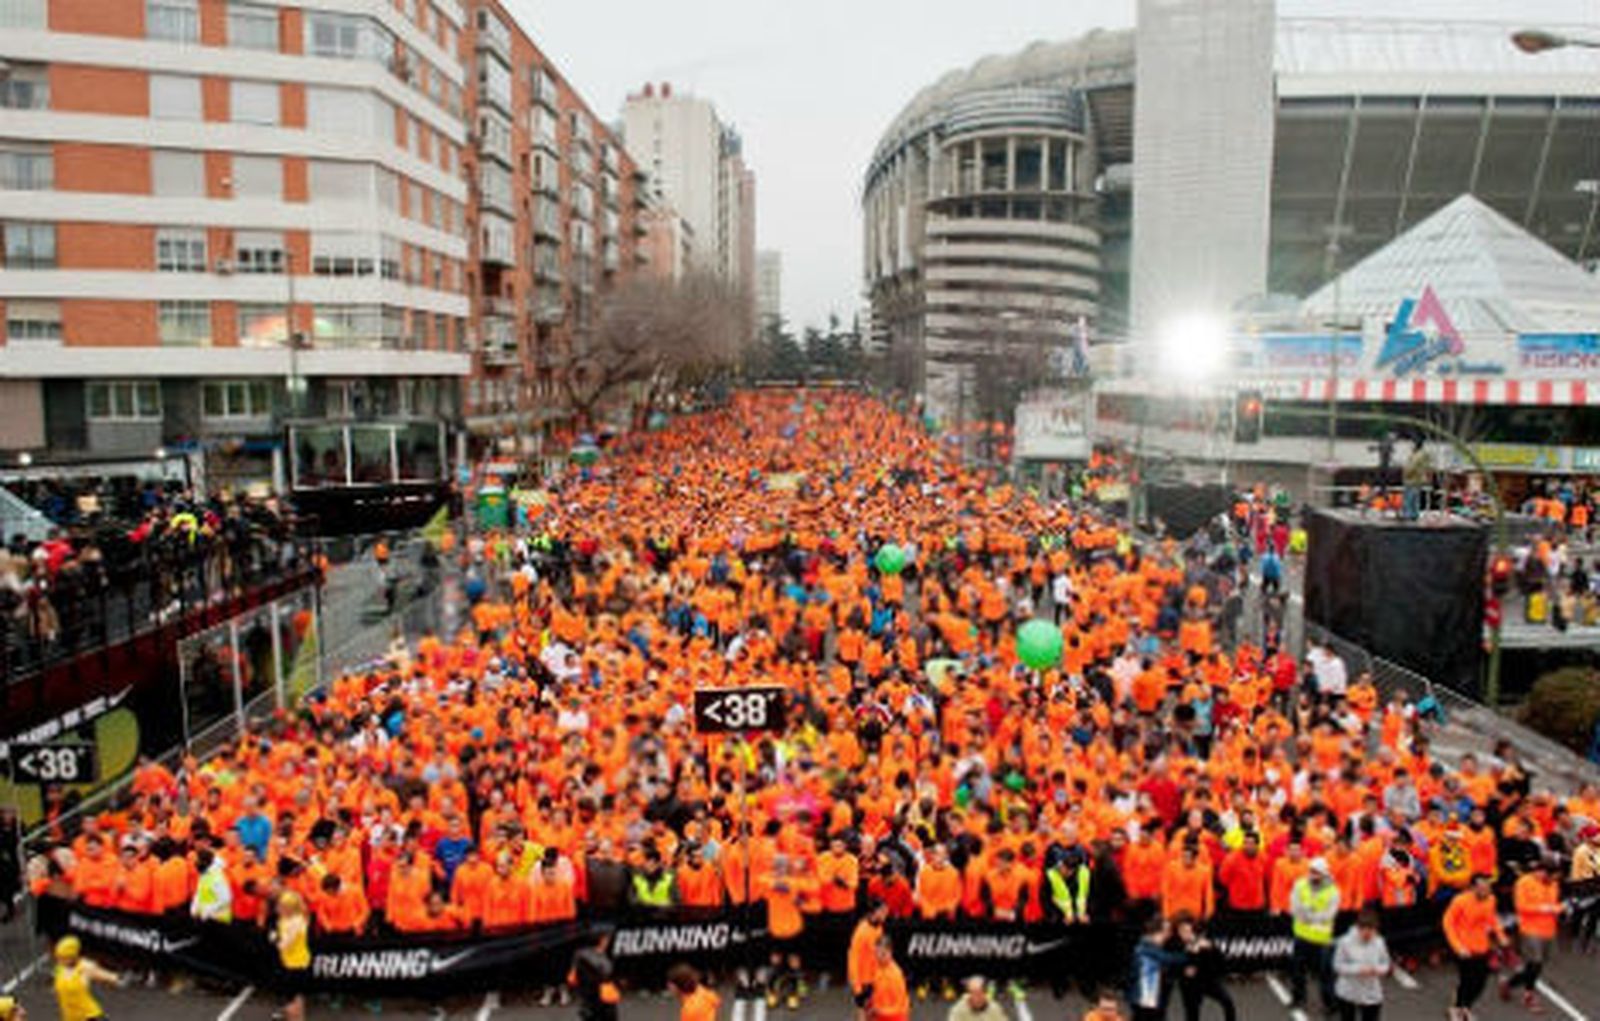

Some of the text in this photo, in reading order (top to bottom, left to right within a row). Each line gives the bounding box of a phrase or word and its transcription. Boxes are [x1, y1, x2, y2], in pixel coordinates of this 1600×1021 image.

[614, 922, 729, 956] RUNNING
[907, 931, 1026, 959] RUNNING
[312, 948, 430, 979] RUNNING
